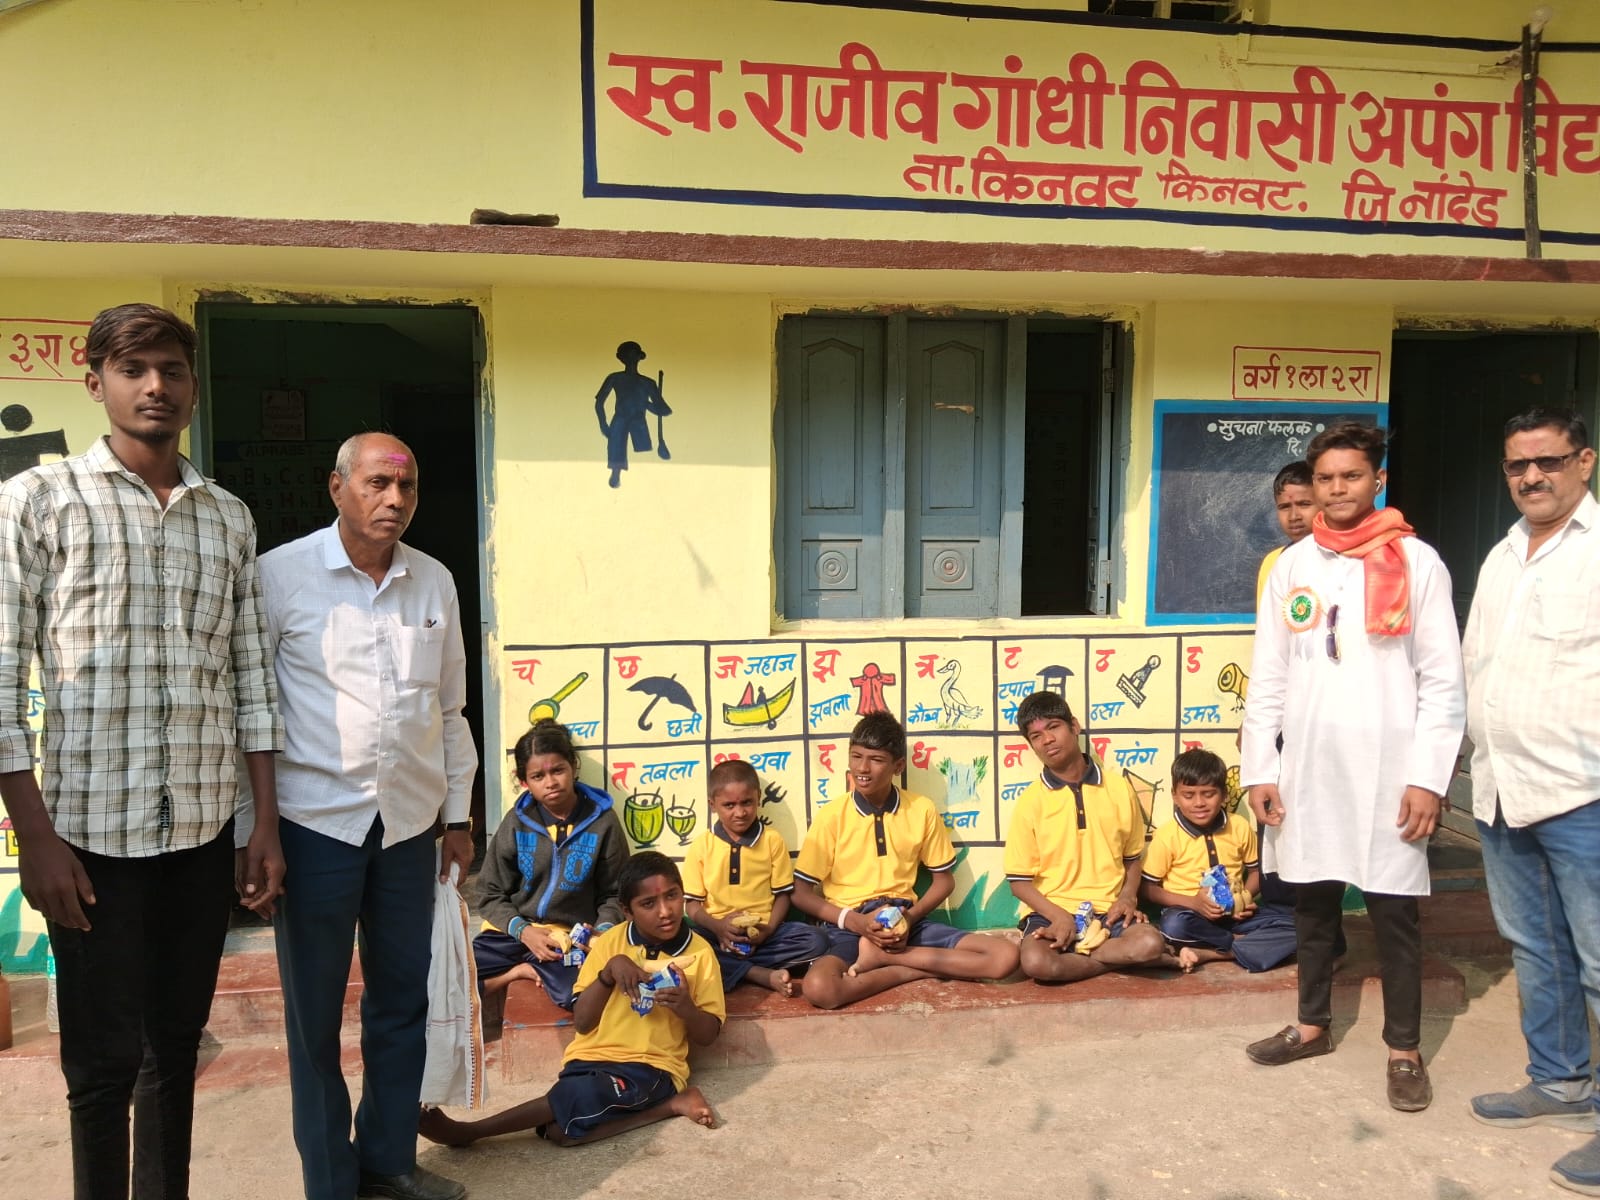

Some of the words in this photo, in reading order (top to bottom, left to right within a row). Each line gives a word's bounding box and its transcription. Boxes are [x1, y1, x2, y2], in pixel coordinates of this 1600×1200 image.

[607, 53, 737, 136] स्व.
[740, 42, 947, 153] राजीव
[951, 51, 1116, 150] गांधी
[1119, 60, 1345, 172] निवासी
[1348, 82, 1500, 171] अपंग
[970, 146, 1143, 208] किनवट
[1341, 169, 1396, 226] जि
[1399, 170, 1507, 228] नांदेड
[1243, 353, 1281, 390] वर्ग
[1217, 419, 1267, 441] सुचना
[1267, 420, 1313, 436] फलक
[613, 655, 642, 679] छ
[714, 655, 743, 679] ज
[744, 653, 797, 676] जहाज
[812, 649, 842, 684] झ
[1004, 646, 1022, 669] ट
[1095, 649, 1116, 672] ठ
[1186, 646, 1204, 673] ड
[512, 658, 541, 685] च
[665, 711, 702, 738] छत्री
[816, 744, 837, 773] द
[911, 741, 937, 770] ध
[1004, 743, 1029, 768] न
[1091, 737, 1112, 762] प
[1114, 741, 1159, 767] पतंग
[611, 762, 635, 790] त
[640, 760, 700, 784] तबला
